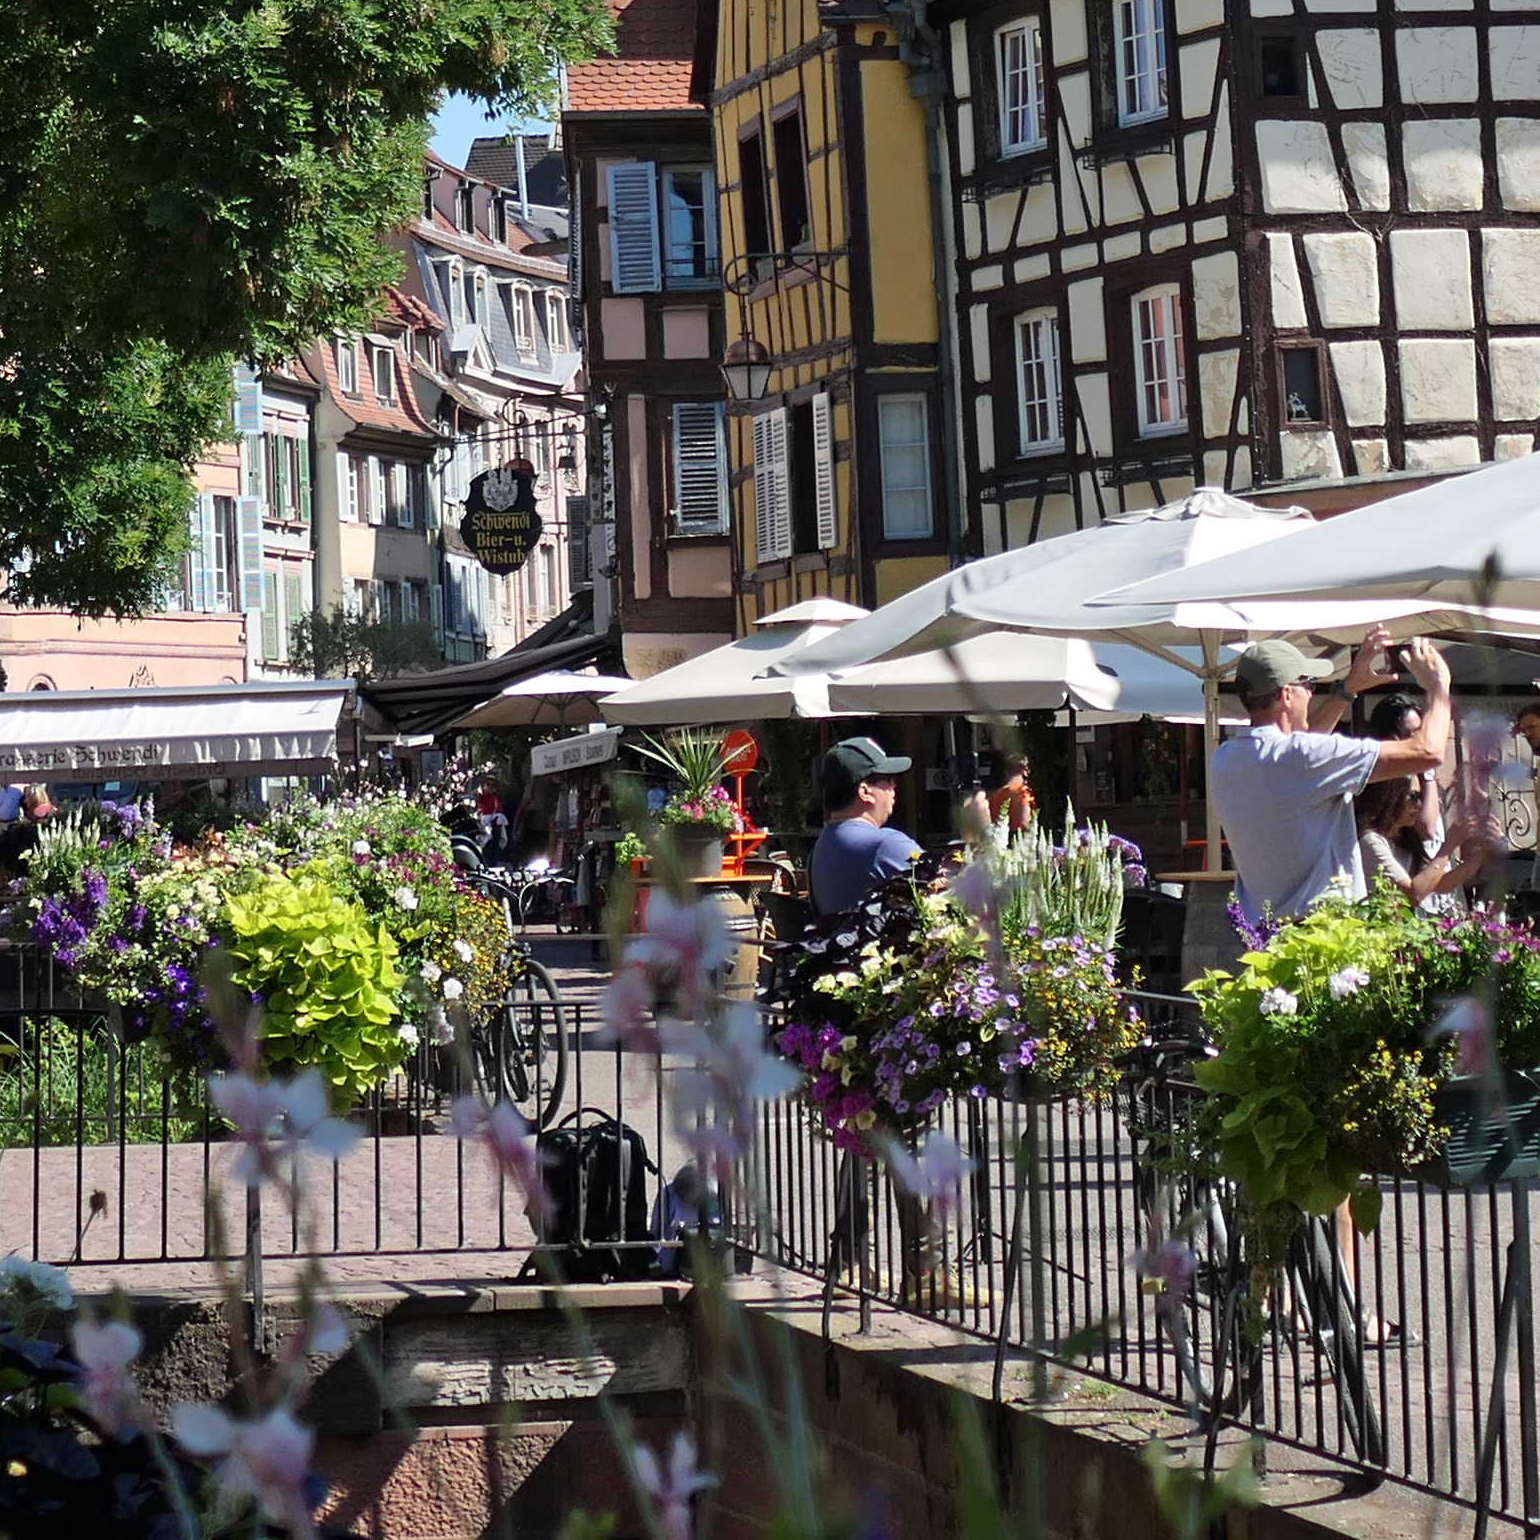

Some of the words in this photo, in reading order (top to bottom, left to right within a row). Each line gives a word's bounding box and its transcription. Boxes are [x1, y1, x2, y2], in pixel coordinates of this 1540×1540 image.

[471, 511, 531, 531] Schwendi
[476, 548, 526, 565] Wistub
[74, 743, 159, 763] Schwendi
